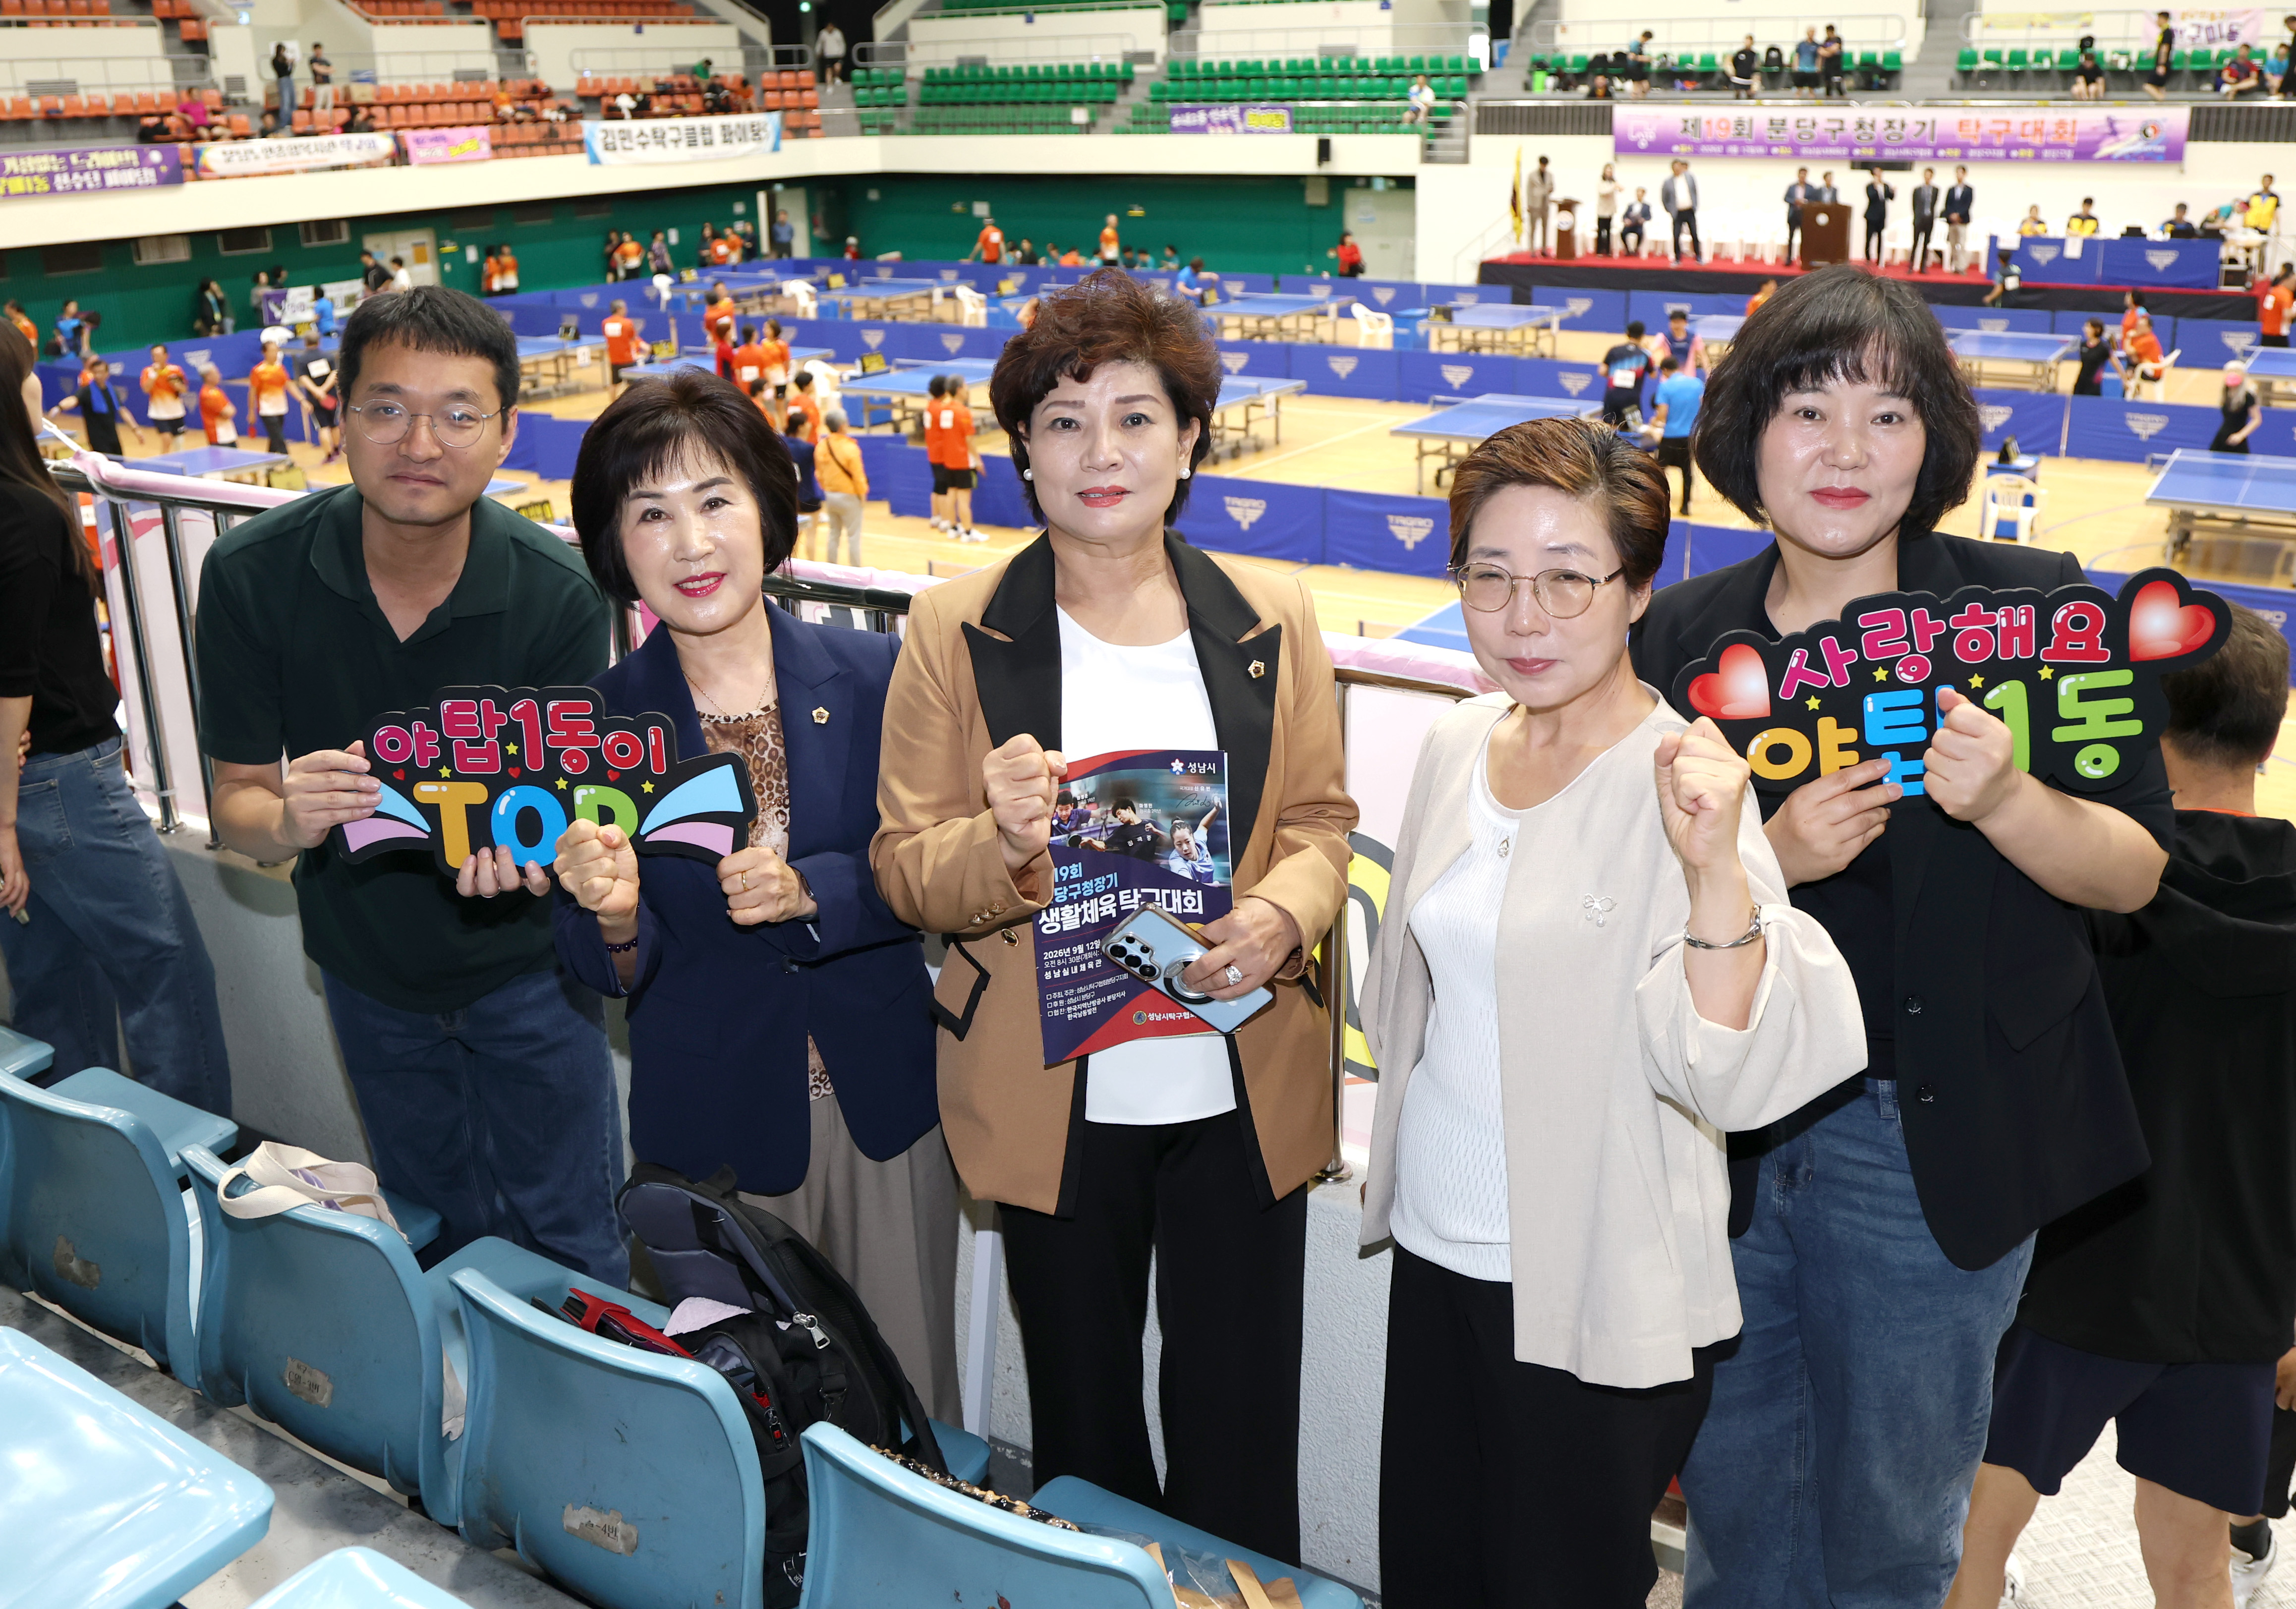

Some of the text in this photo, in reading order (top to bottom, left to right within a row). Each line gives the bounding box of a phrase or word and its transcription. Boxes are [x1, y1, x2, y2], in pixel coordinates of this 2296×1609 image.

[600, 124, 714, 151] 김민수탁구클럽
[1679, 116, 1754, 143] 제19회
[1766, 116, 1938, 144] 분당구청장기
[1957, 117, 2078, 146] 탁구대회
[1779, 600, 2111, 700] 사랑해요
[373, 698, 667, 775] 야탑1동이
[1187, 762, 1216, 774] 성남시
[412, 781, 639, 869] TOP
[1050, 872, 1118, 904] 당구청장기
[1038, 893, 1117, 934] 생활체육
[1043, 939, 1101, 960] 2026년 9월 12일
[1044, 959, 1102, 980] 성남실내체육관
[1067, 996, 1081, 1005] 성남시
[1082, 991, 1095, 1001] 분당구
[1106, 990, 1126, 1002] 분당지사
[1067, 1006, 1097, 1021] 한국남동발전
